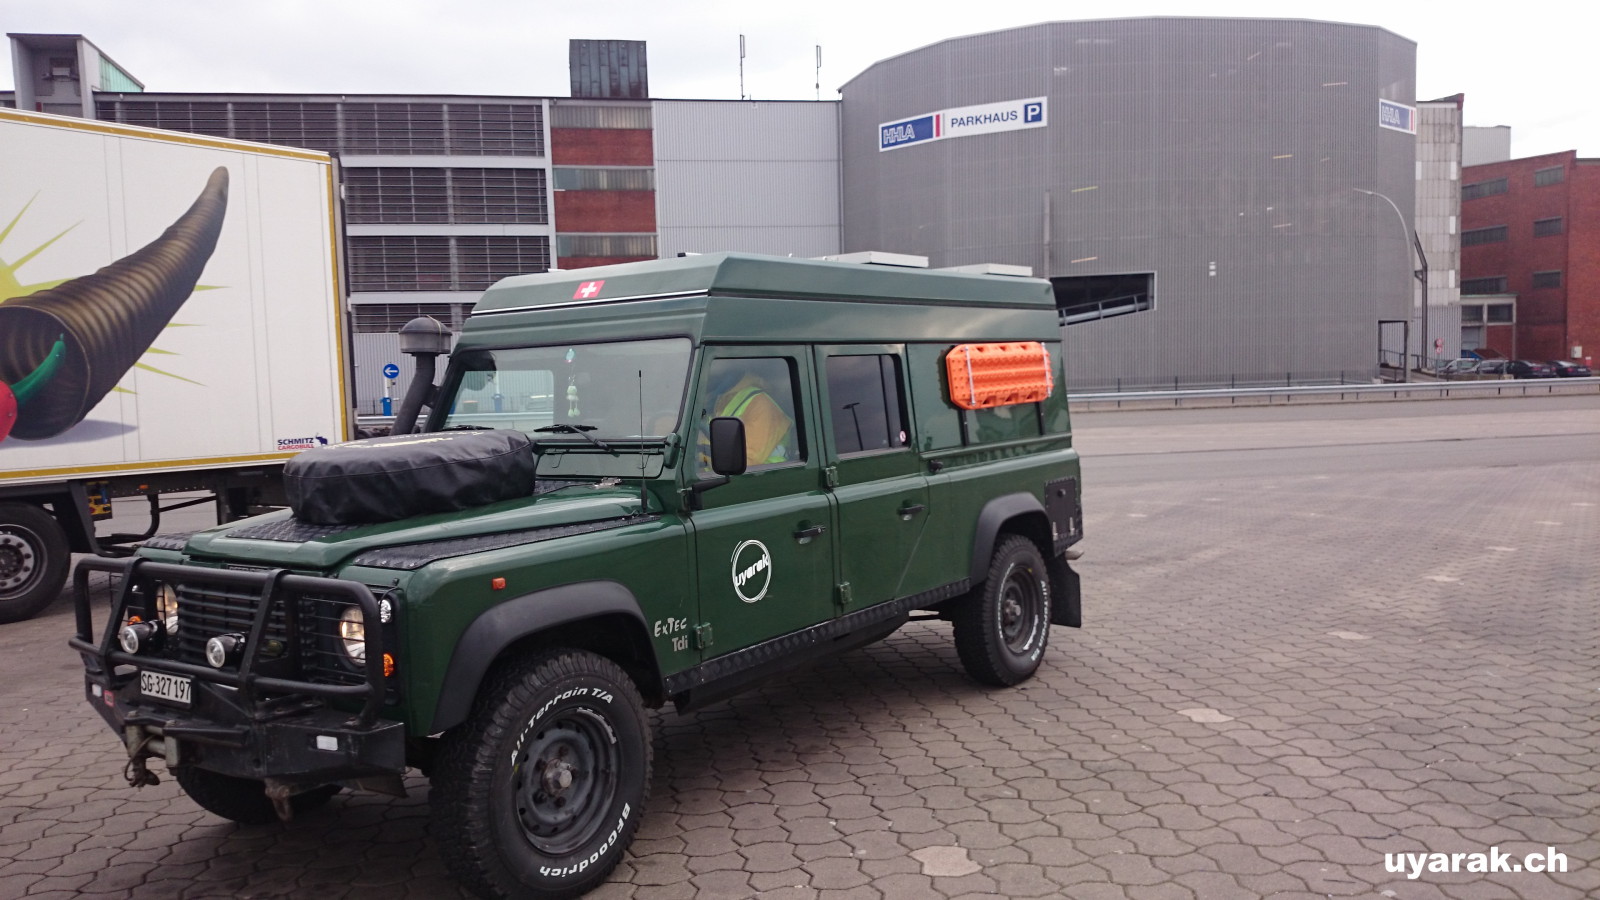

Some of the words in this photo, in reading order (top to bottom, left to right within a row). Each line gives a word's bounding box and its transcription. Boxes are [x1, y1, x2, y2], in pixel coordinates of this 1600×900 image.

[883, 124, 915, 144] HHLA
[951, 110, 1018, 128] PARKHAUS
[1027, 104, 1040, 122] P
[278, 437, 314, 445] SCHMITZ
[734, 553, 769, 587] uyarak
[671, 635, 688, 652] Tdi
[592, 687, 614, 704] T/A
[539, 802, 631, 878] BFGoodrich
